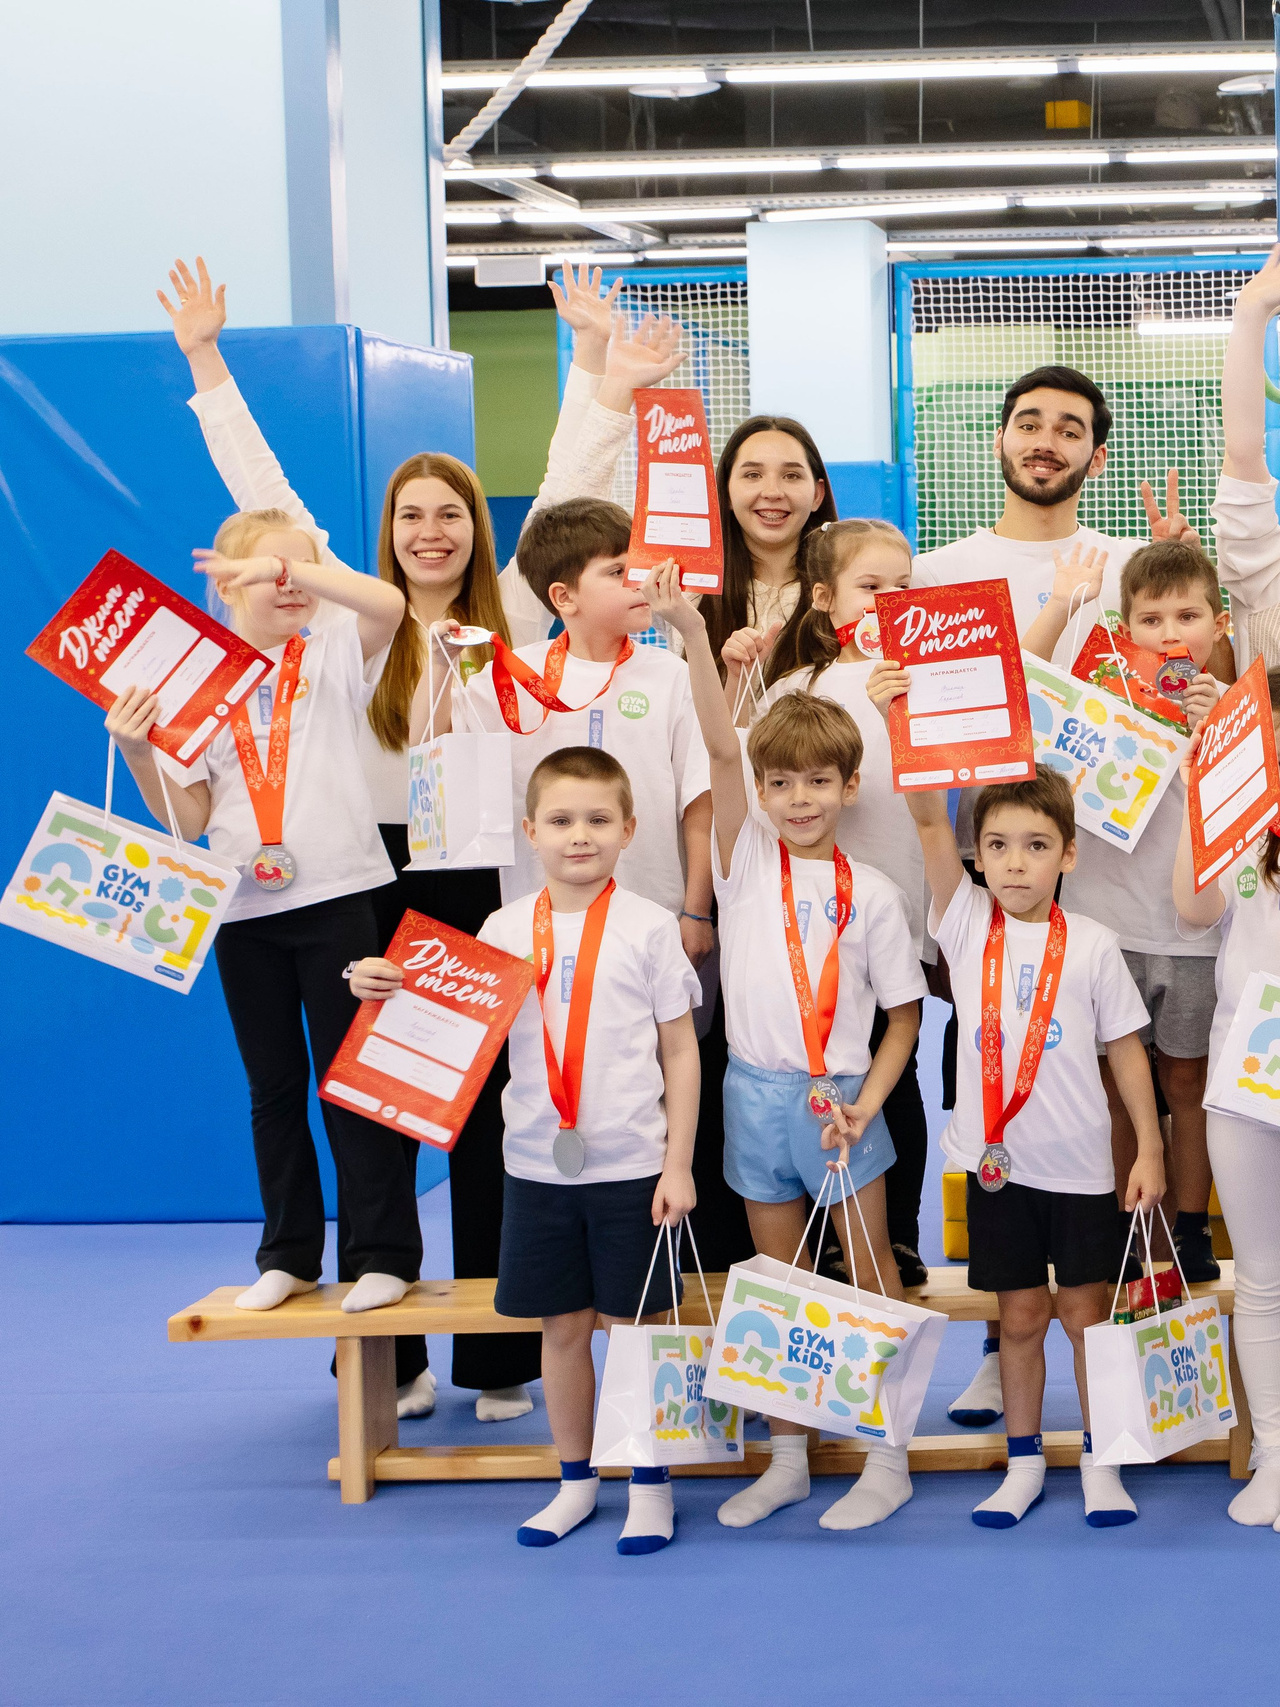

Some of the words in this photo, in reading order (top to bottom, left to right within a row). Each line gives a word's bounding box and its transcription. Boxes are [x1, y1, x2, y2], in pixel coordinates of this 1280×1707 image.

[644, 404, 695, 443] Джим
[658, 431, 702, 455] тест
[58, 583, 124, 669] Джим
[92, 587, 145, 662] тест
[894, 605, 985, 647] Джим
[920, 624, 998, 656] тест
[930, 667, 977, 676] НАГРАЖДАЕТСЯ
[621, 695, 647, 707] GYM
[1062, 717, 1107, 753] GYM
[1197, 693, 1251, 766] Джим
[1208, 701, 1258, 765] тест
[103, 864, 151, 897] GYM
[1239, 872, 1256, 884] GYM
[403, 937, 501, 988] Джим
[415, 972, 503, 1009] тест
[788, 1326, 836, 1358] GYM
[1171, 1346, 1196, 1368] GYM
